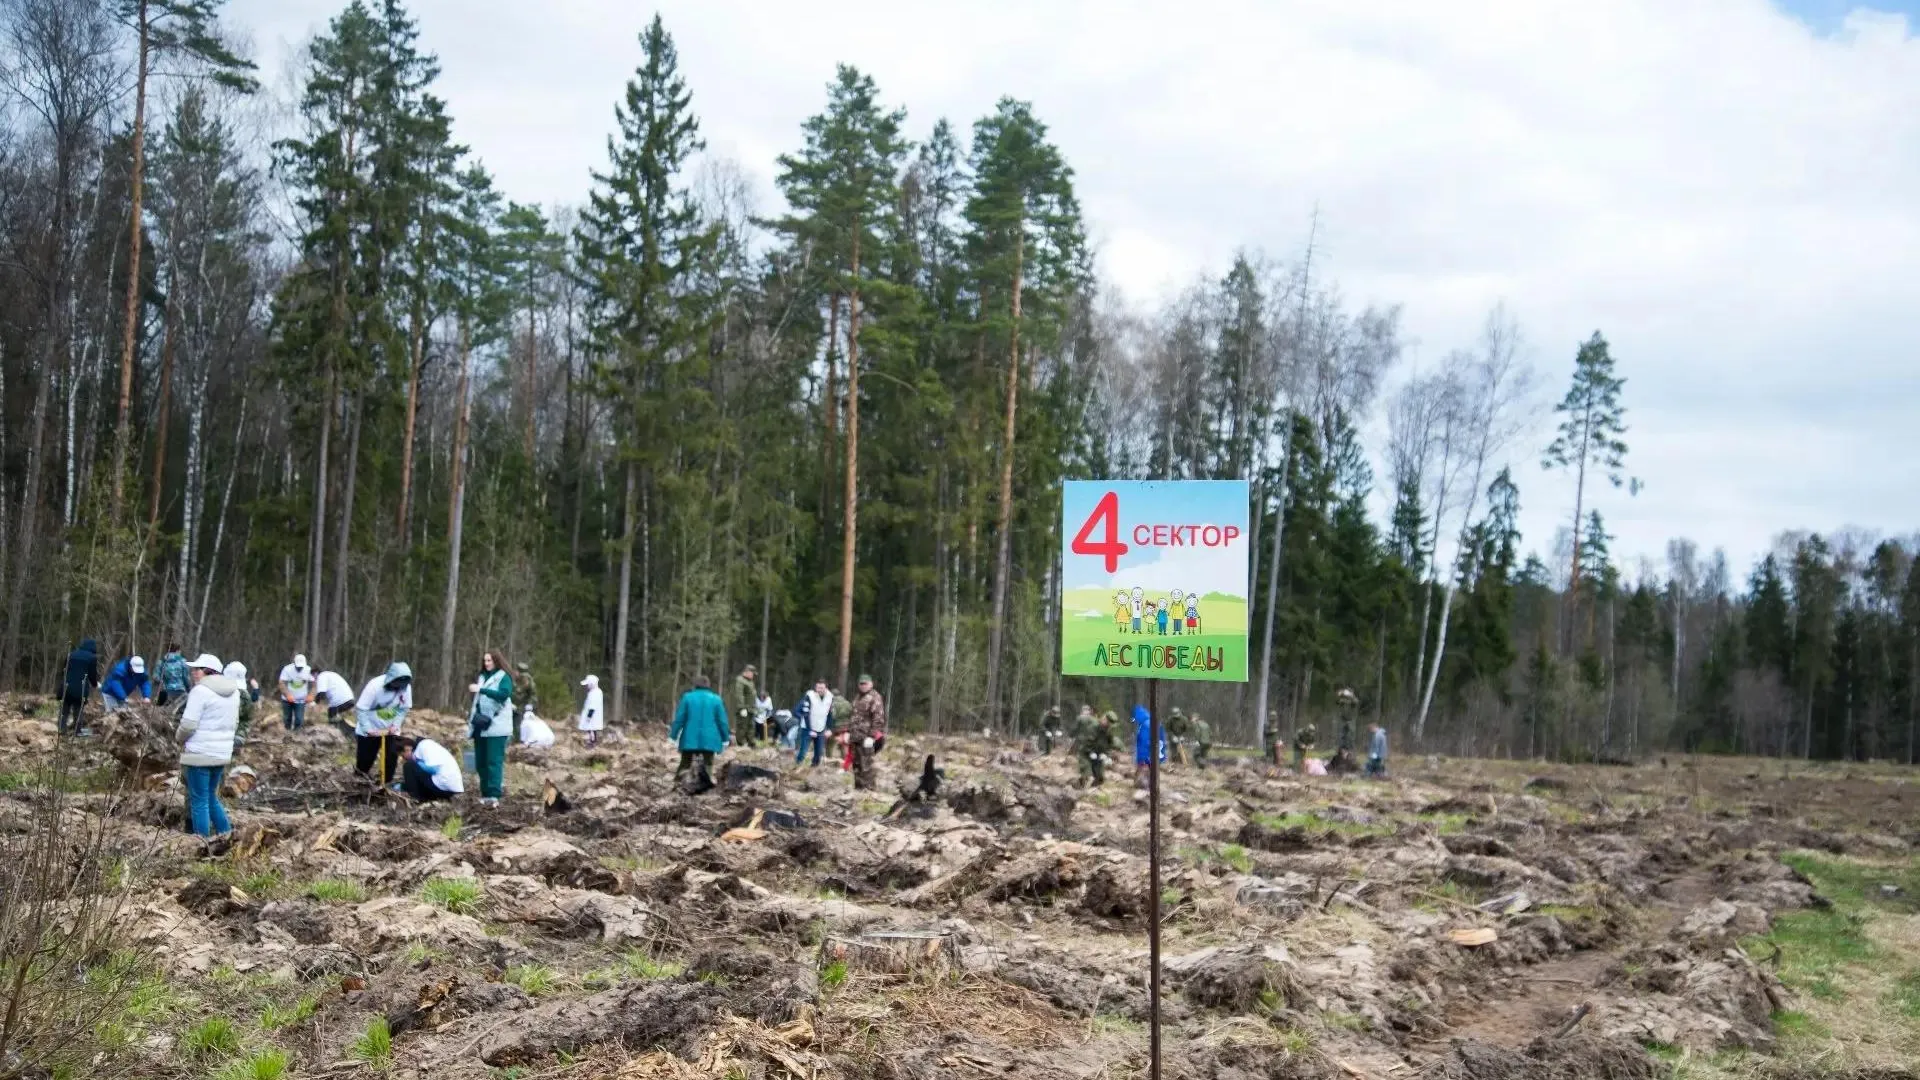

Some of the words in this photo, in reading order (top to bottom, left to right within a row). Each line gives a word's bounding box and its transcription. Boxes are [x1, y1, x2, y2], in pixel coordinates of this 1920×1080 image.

[1071, 491, 1128, 573] 4
[1133, 524, 1240, 547] СЕКТОР
[1094, 642, 1133, 667] ЛЕС
[1138, 644, 1223, 672] ПОБЕДЫ
